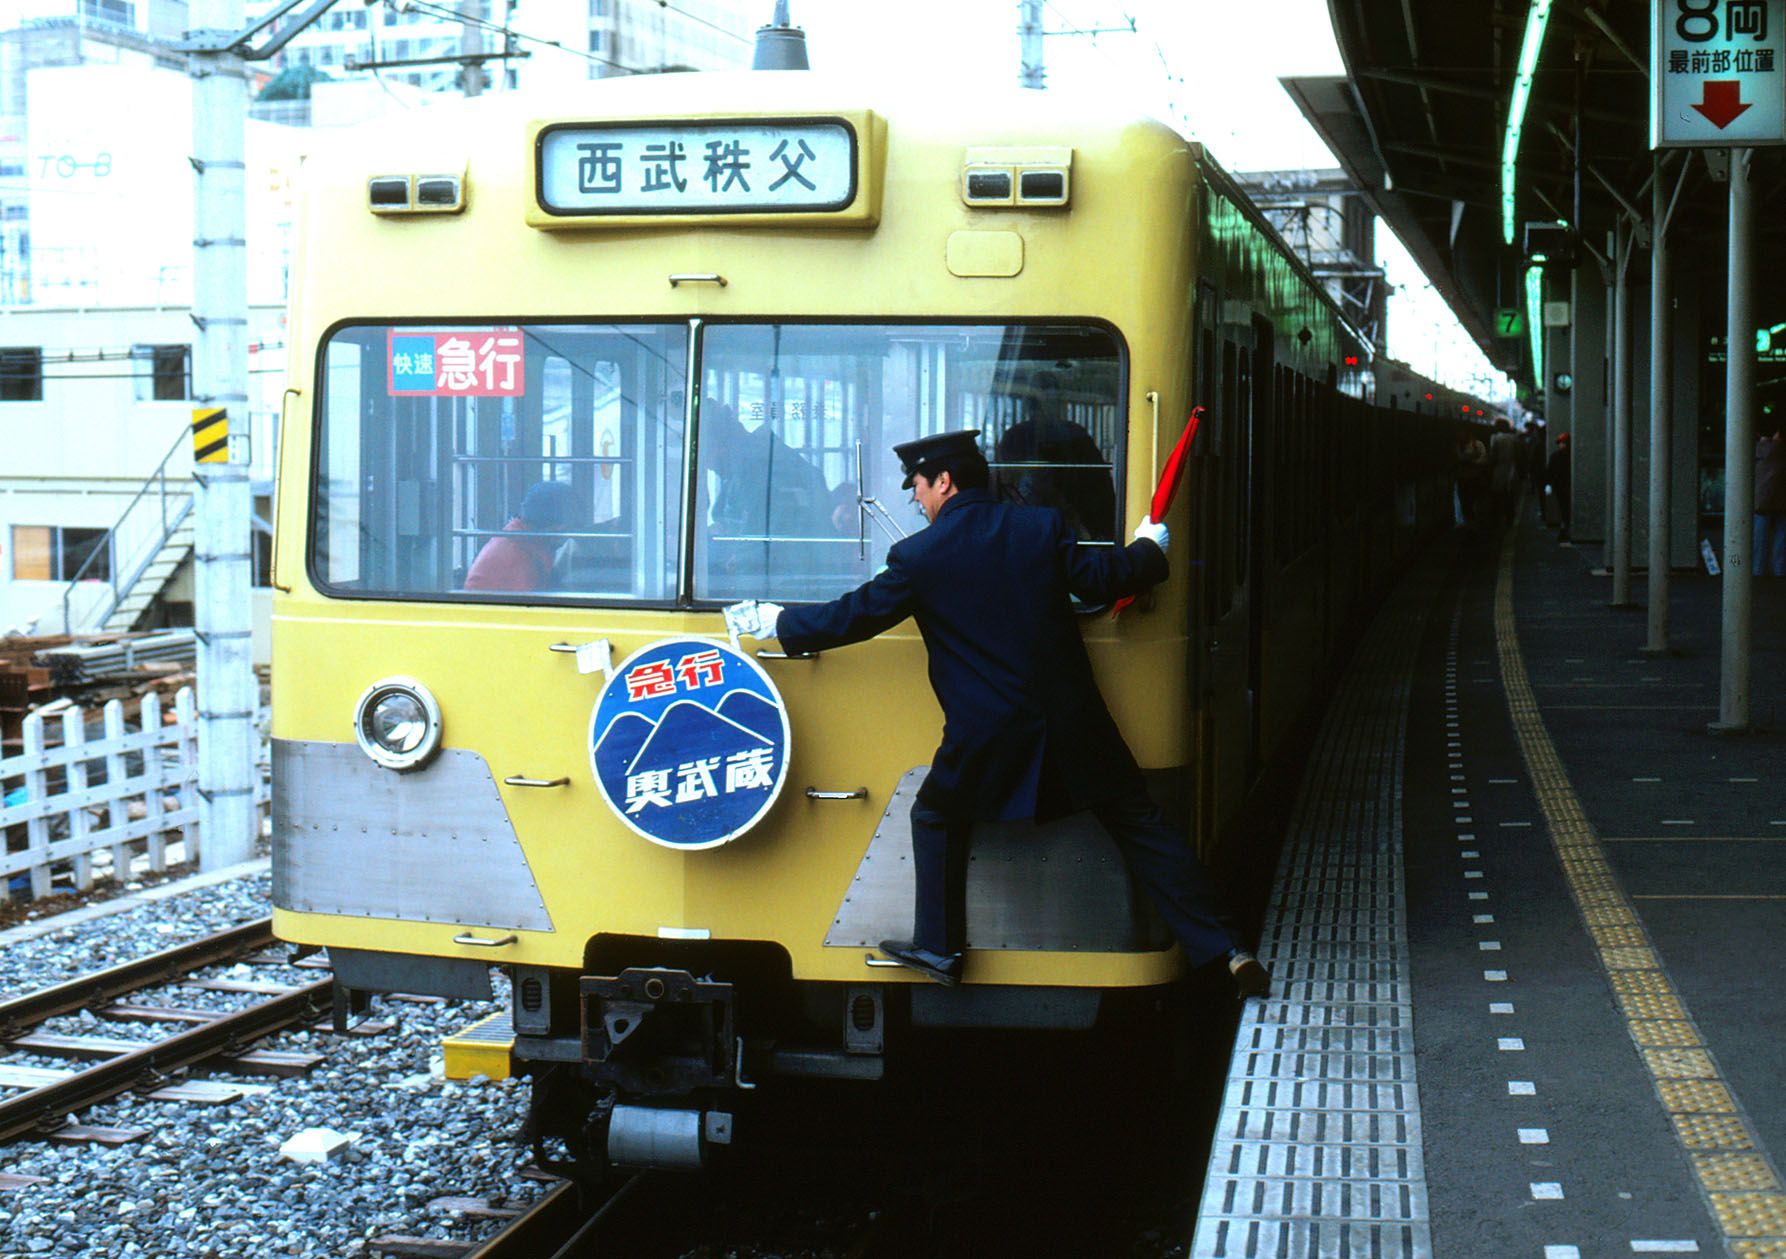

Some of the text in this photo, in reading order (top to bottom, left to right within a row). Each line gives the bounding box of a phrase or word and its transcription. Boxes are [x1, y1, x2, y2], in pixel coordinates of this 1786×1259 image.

[1668, 48, 1775, 74] 最前部位置
[576, 138, 818, 195] 西武秩父
[1502, 312, 1517, 333] 7
[393, 336, 521, 391] 快速 急行
[625, 649, 725, 702] 急行
[624, 747, 775, 815] 奥武蔵
